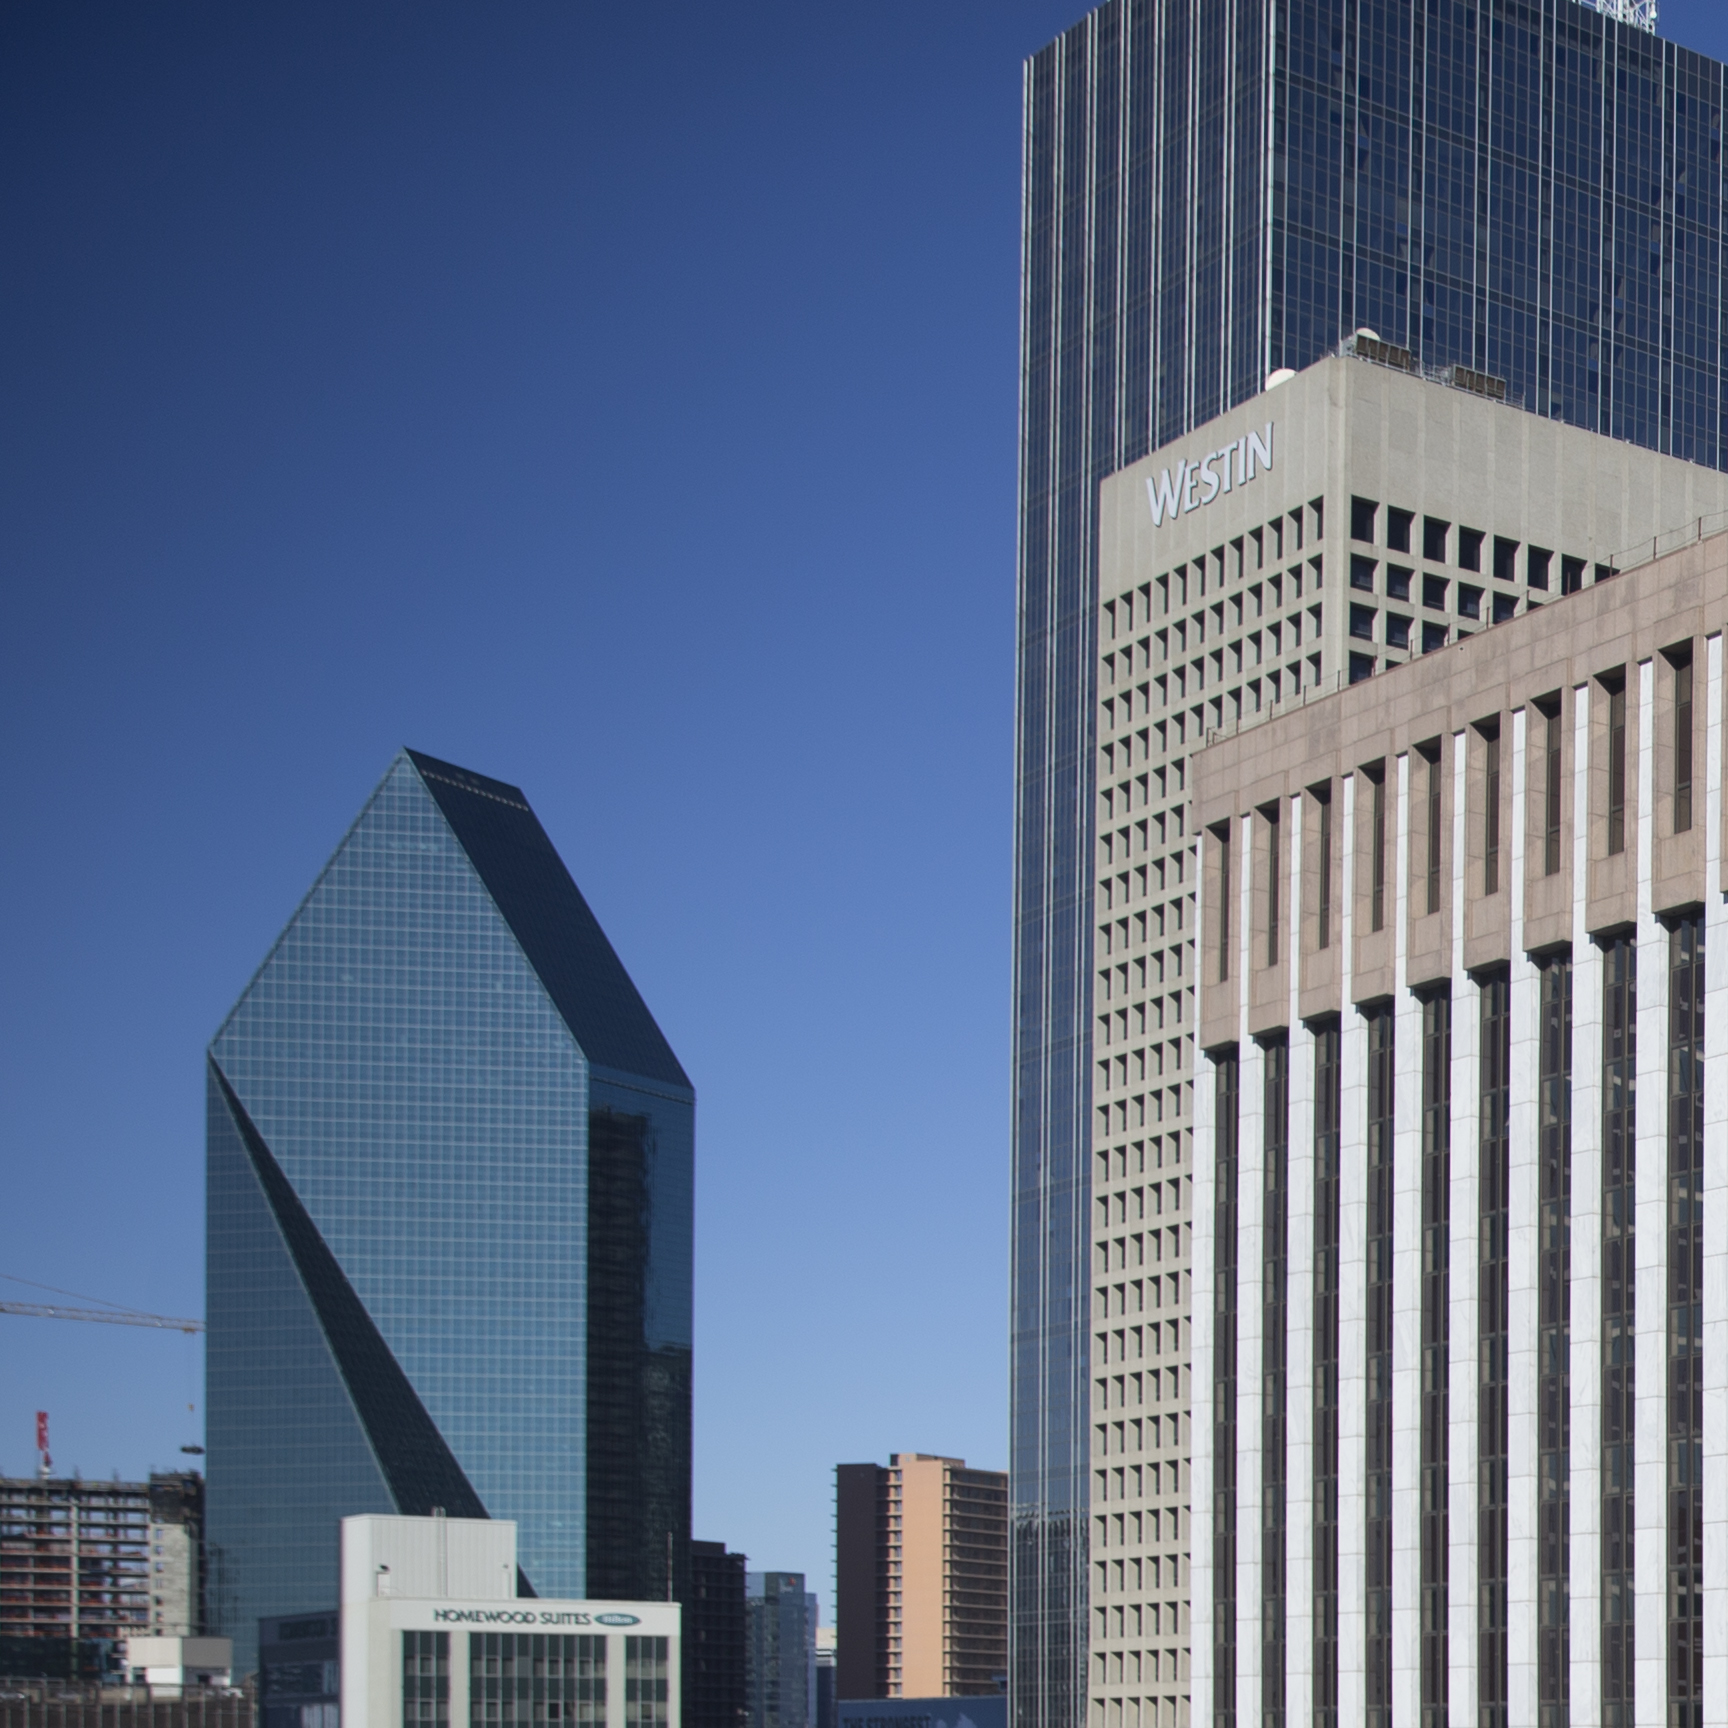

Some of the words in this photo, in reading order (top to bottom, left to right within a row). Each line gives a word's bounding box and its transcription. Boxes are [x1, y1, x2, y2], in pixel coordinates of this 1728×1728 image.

[1145, 421, 1274, 527] WESTIN
[434, 1608, 536, 1624] HOMEWOOD
[540, 1612, 592, 1626] SUITES
